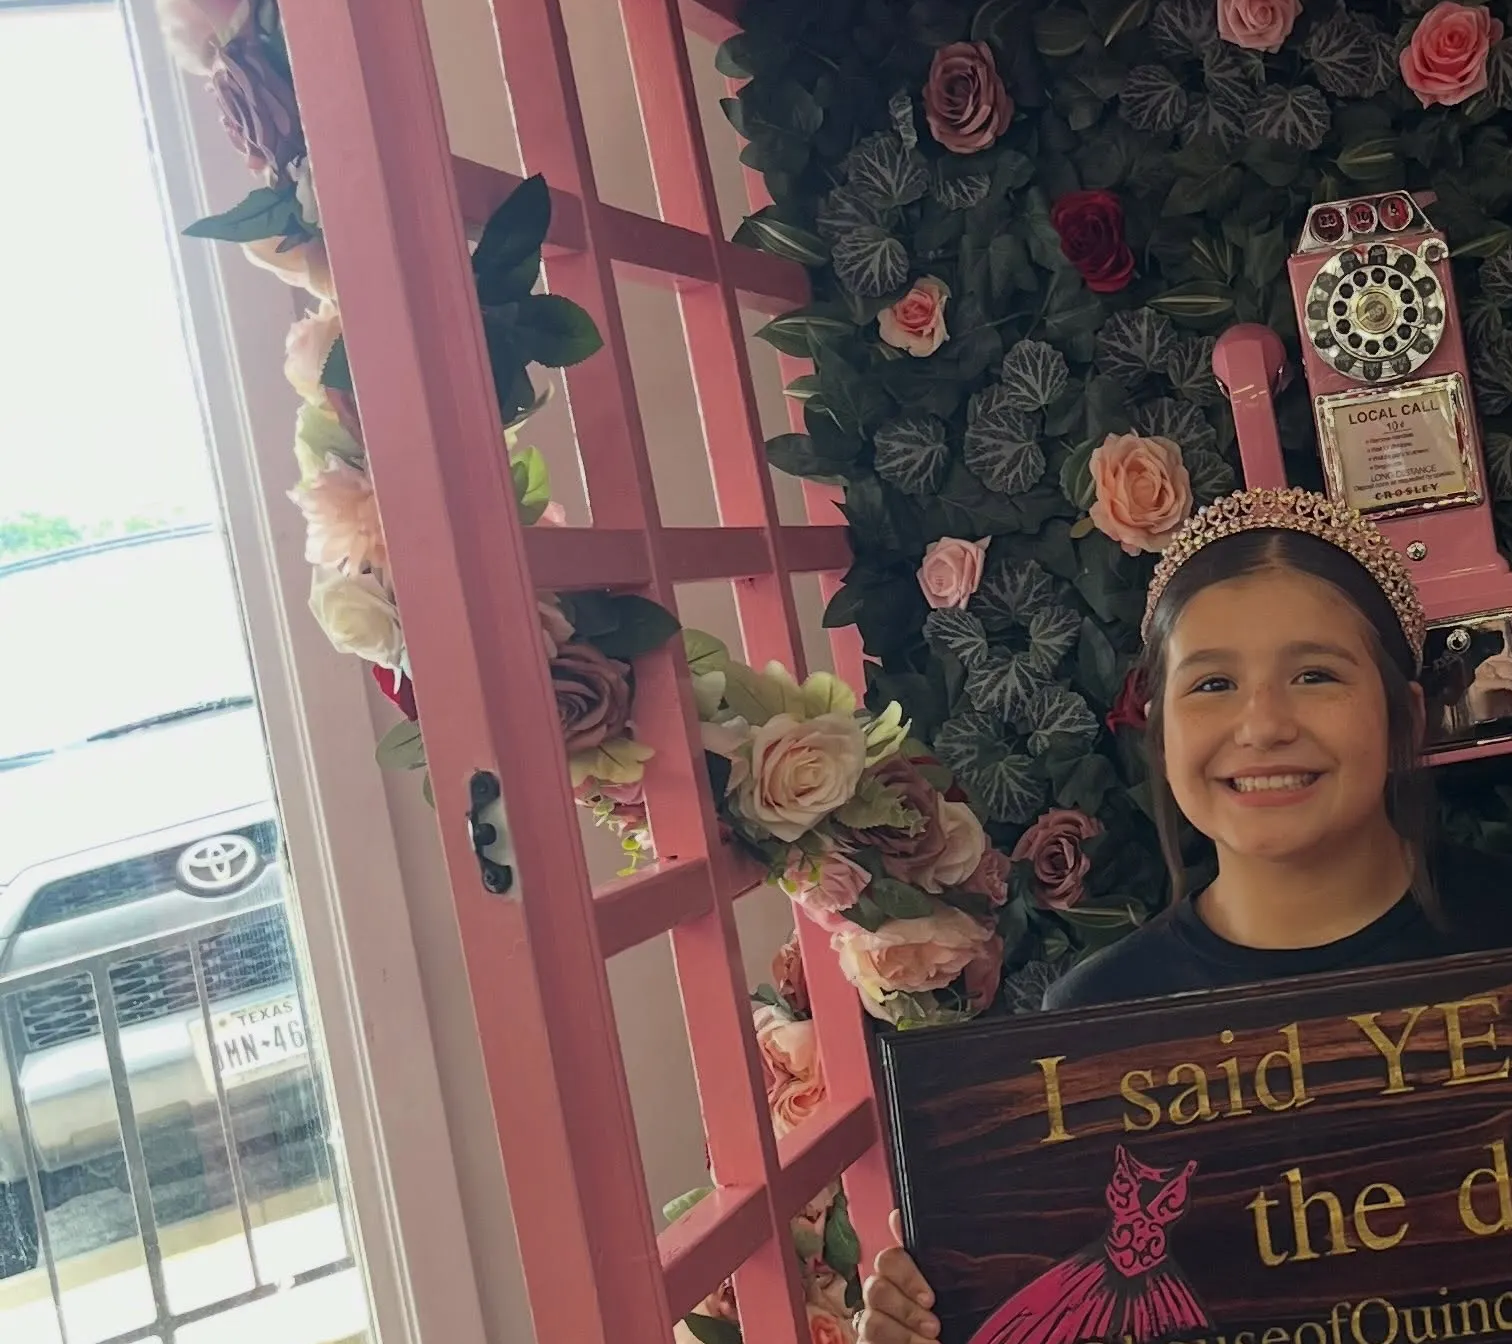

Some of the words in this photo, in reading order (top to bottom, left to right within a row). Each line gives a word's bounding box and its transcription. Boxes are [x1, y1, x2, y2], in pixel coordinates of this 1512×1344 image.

[1348, 407, 1397, 425] LOCAL
[1401, 399, 1440, 416] CALL
[237, 1001, 293, 1026] TEXAS
[1032, 1054, 1075, 1144] I
[1122, 1022, 1316, 1134] said
[1246, 1166, 1410, 1267] the
